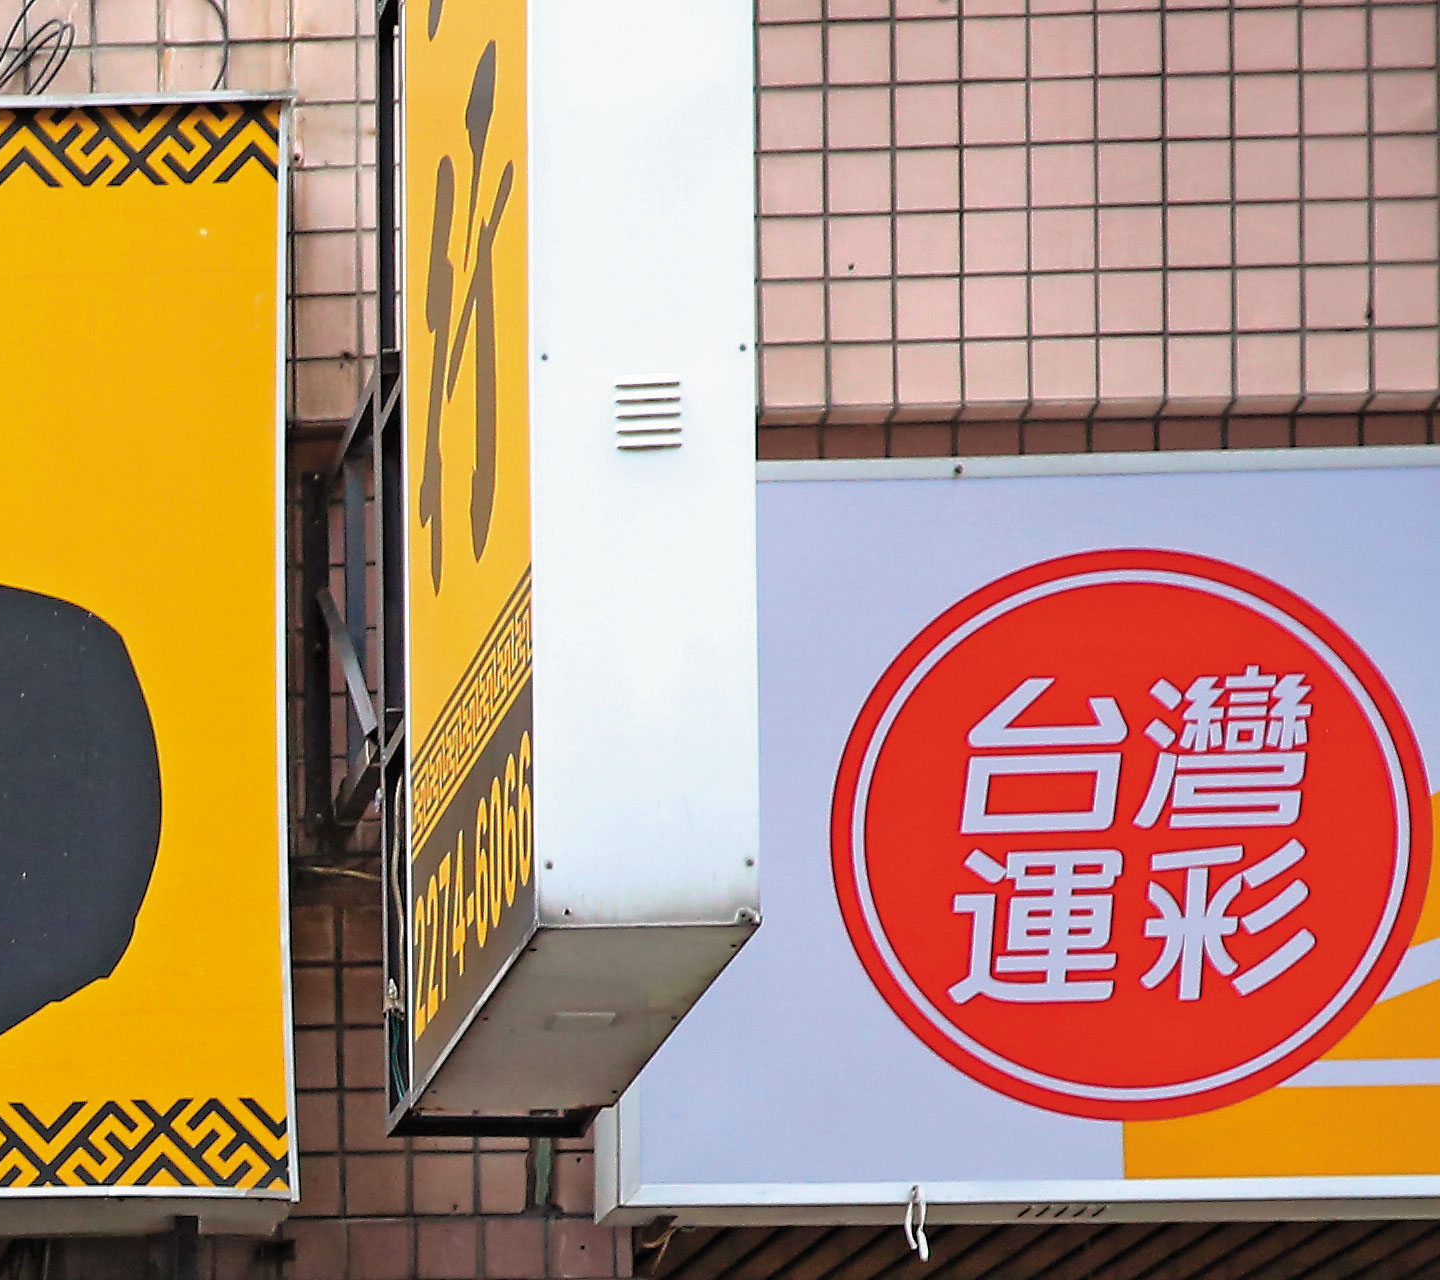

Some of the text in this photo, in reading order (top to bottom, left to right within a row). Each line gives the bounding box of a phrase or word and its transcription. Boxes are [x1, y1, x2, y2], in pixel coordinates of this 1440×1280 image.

[959, 664, 1314, 835] 台灣
[414, 730, 532, 1042] 2274-6066
[946, 837, 1318, 1005] 運彩
